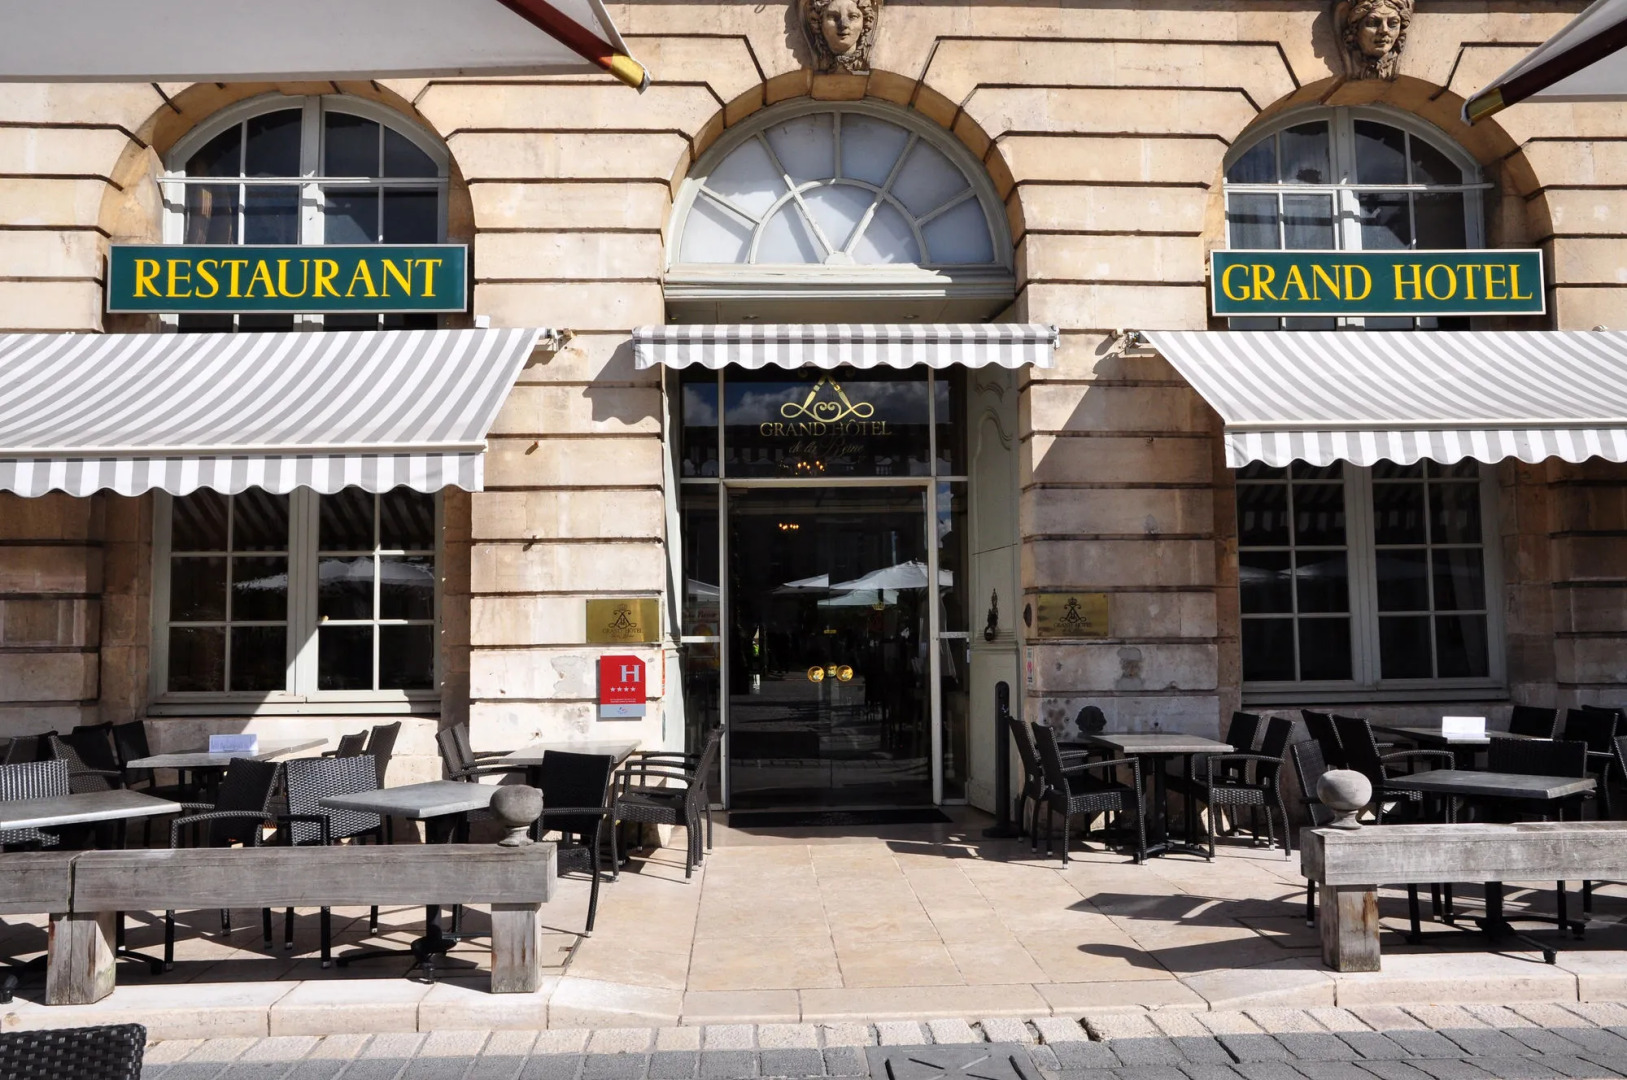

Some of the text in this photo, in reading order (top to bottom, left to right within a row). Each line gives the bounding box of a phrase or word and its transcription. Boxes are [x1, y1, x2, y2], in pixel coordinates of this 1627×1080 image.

[132, 258, 443, 298] RESTAURANT
[1221, 263, 1533, 301] GRAND HOTEL
[759, 418, 893, 437] GRAND HÔTEL
[619, 664, 642, 683] H
